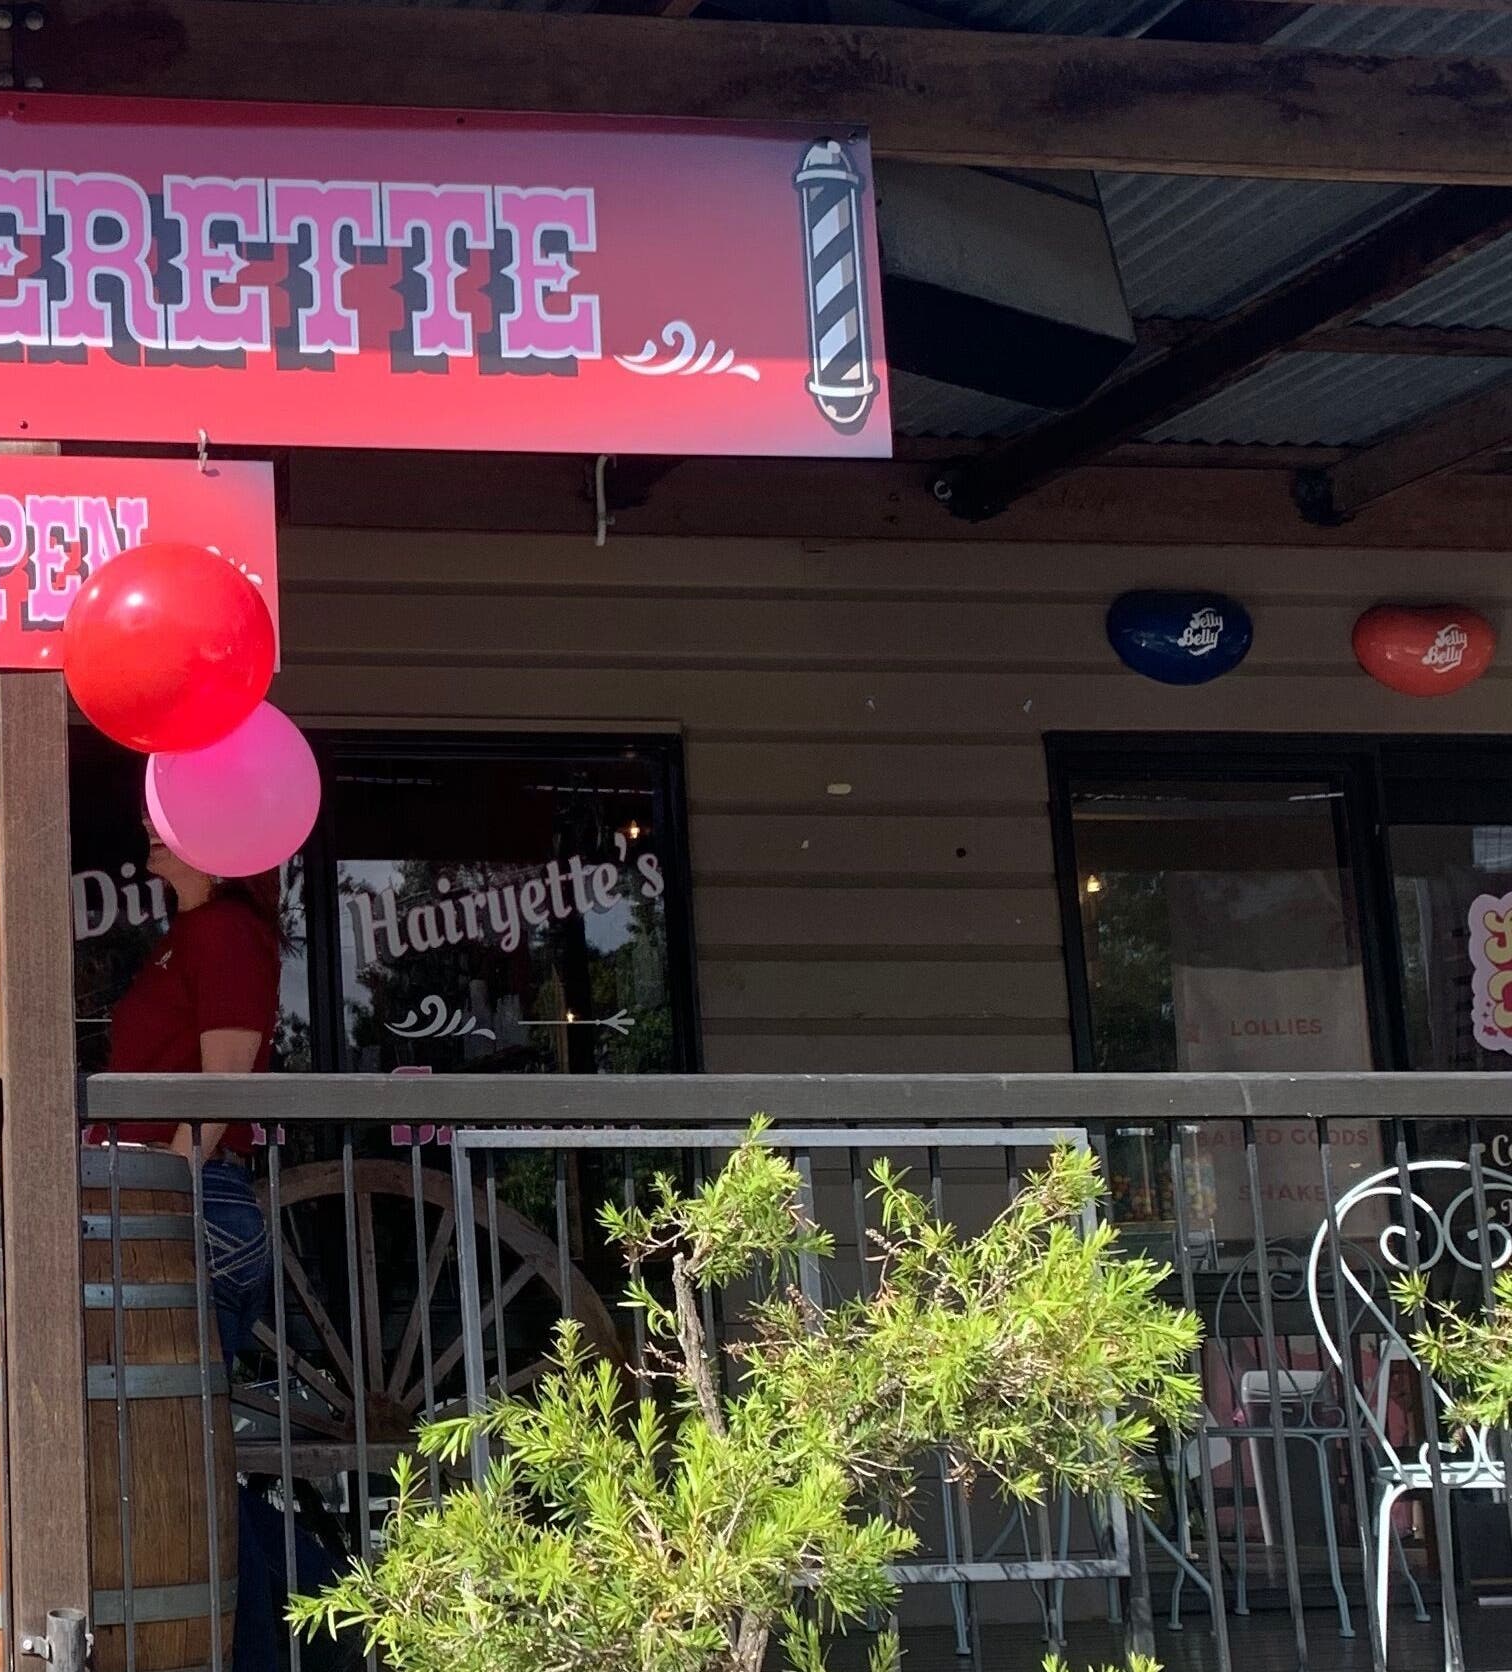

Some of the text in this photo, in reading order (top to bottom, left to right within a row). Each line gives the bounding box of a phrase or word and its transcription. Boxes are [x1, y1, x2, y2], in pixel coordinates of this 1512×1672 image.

[1189, 607, 1223, 632] Jelly
[1177, 627, 1219, 656] Belly
[1435, 623, 1468, 648] Jelly
[1421, 646, 1462, 674] Belly
[352, 832, 666, 966] Hairyette's
[1229, 1018, 1323, 1038] LOLLIES
